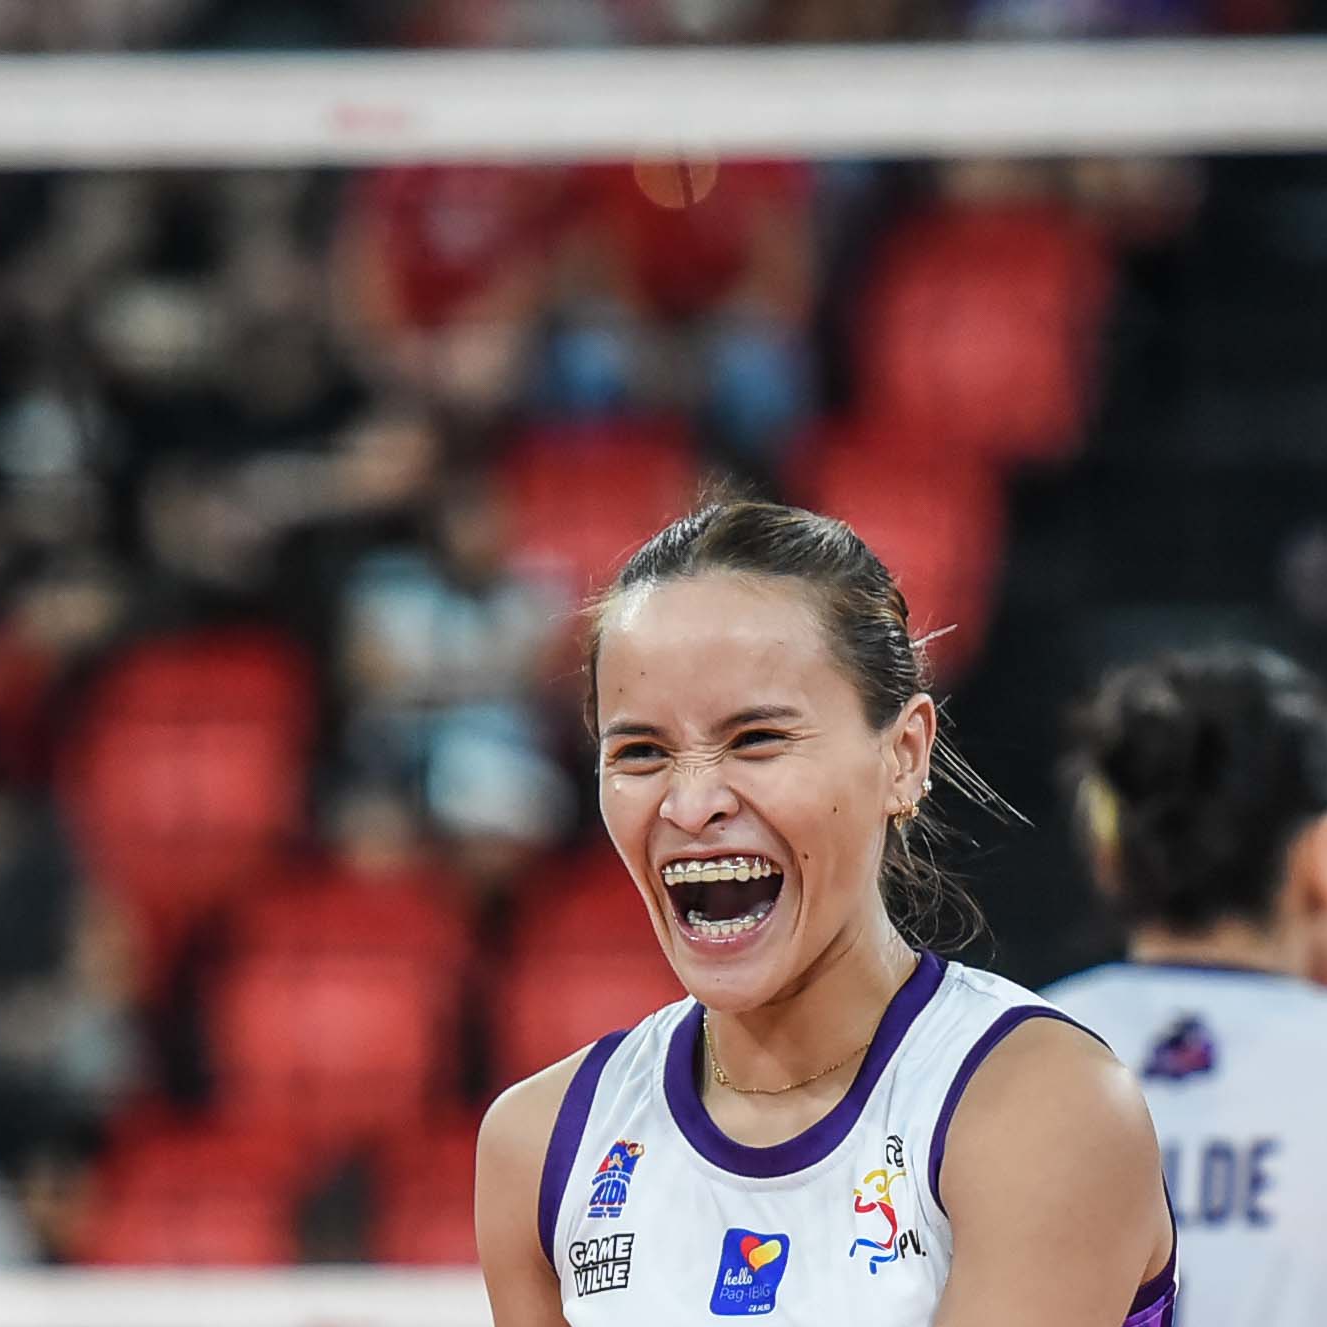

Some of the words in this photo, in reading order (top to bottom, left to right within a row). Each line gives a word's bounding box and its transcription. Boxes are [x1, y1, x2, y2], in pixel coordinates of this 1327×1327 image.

[569, 1234, 635, 1269] GAME
[899, 1229, 927, 1259] PV
[574, 1260, 631, 1297] VILLE
[723, 1267, 753, 1286] hello
